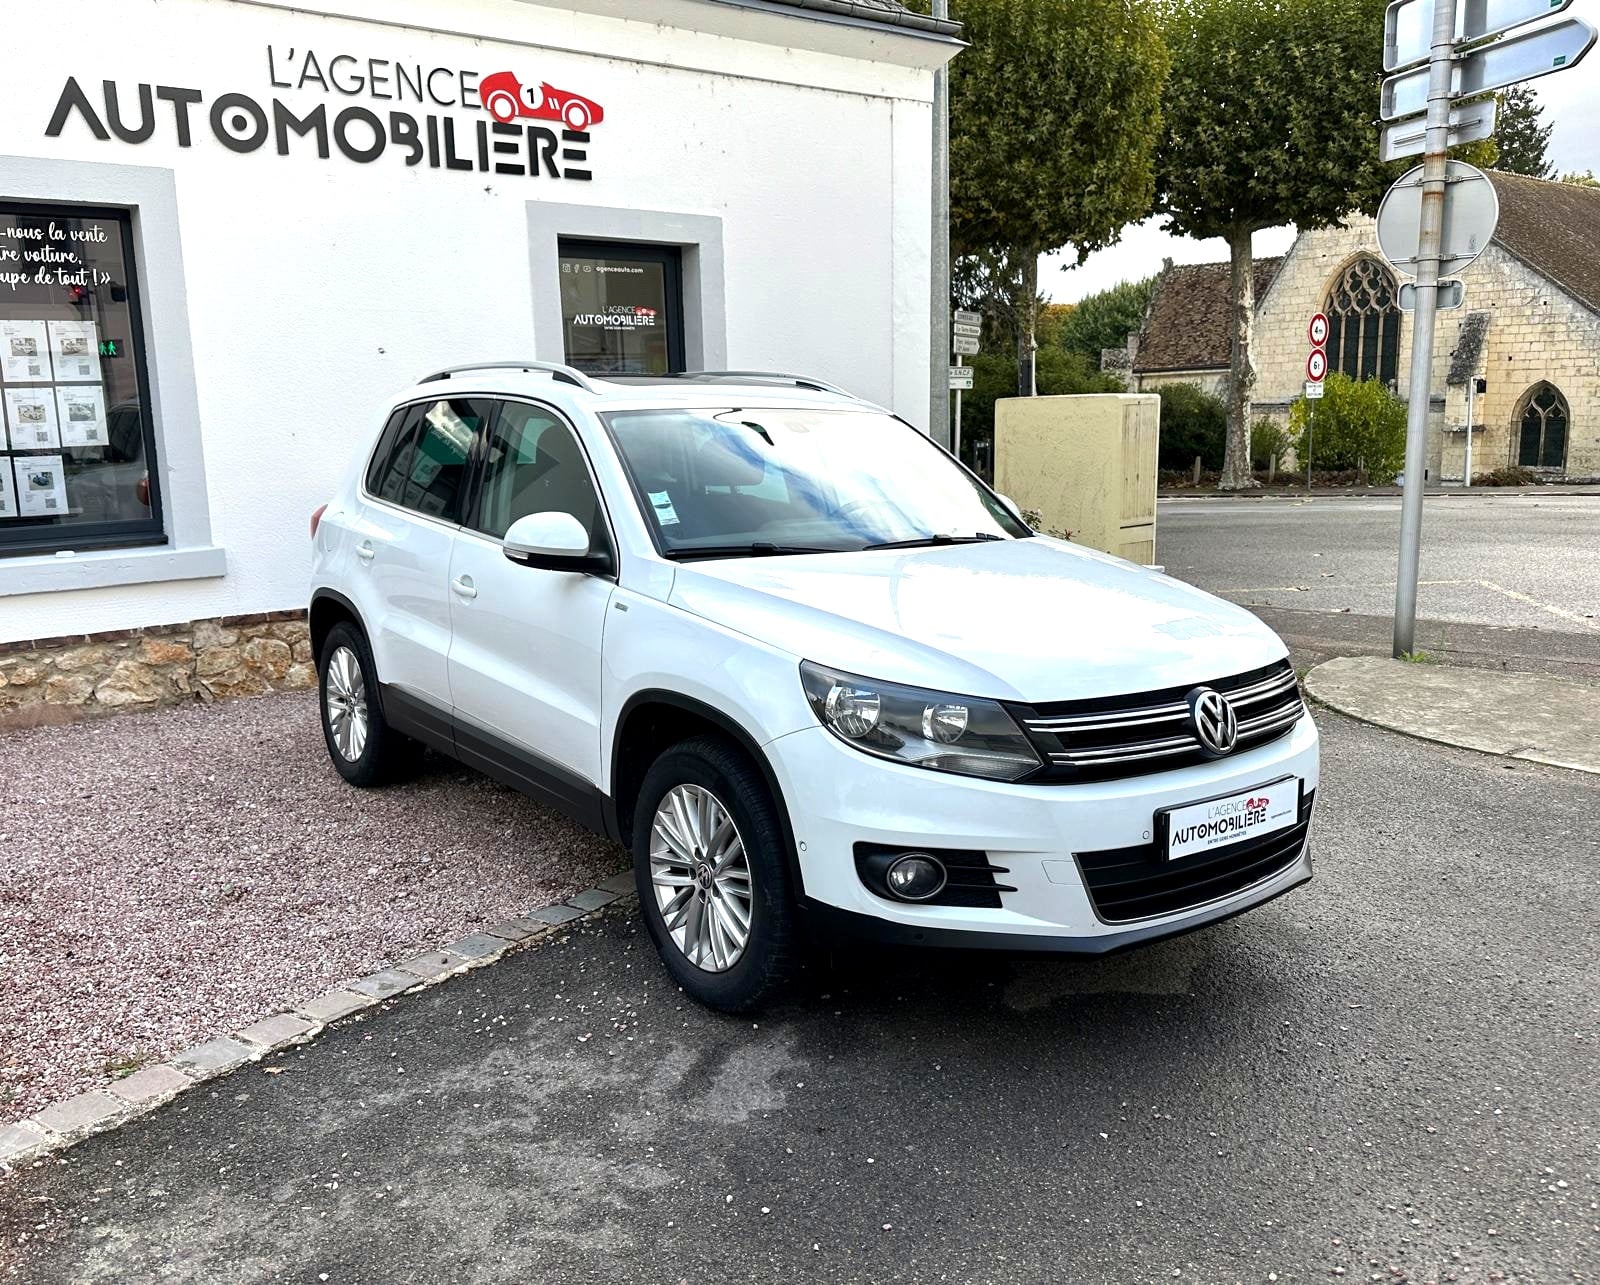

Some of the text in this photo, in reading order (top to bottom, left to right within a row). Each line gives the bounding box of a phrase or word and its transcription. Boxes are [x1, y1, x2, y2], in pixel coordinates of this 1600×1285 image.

[267, 45, 482, 109] L'AGENCE
[48, 221, 67, 241] la
[70, 224, 108, 243] vente
[23, 244, 82, 265] voiture,
[34, 265, 55, 285] de
[52, 267, 90, 287] tout
